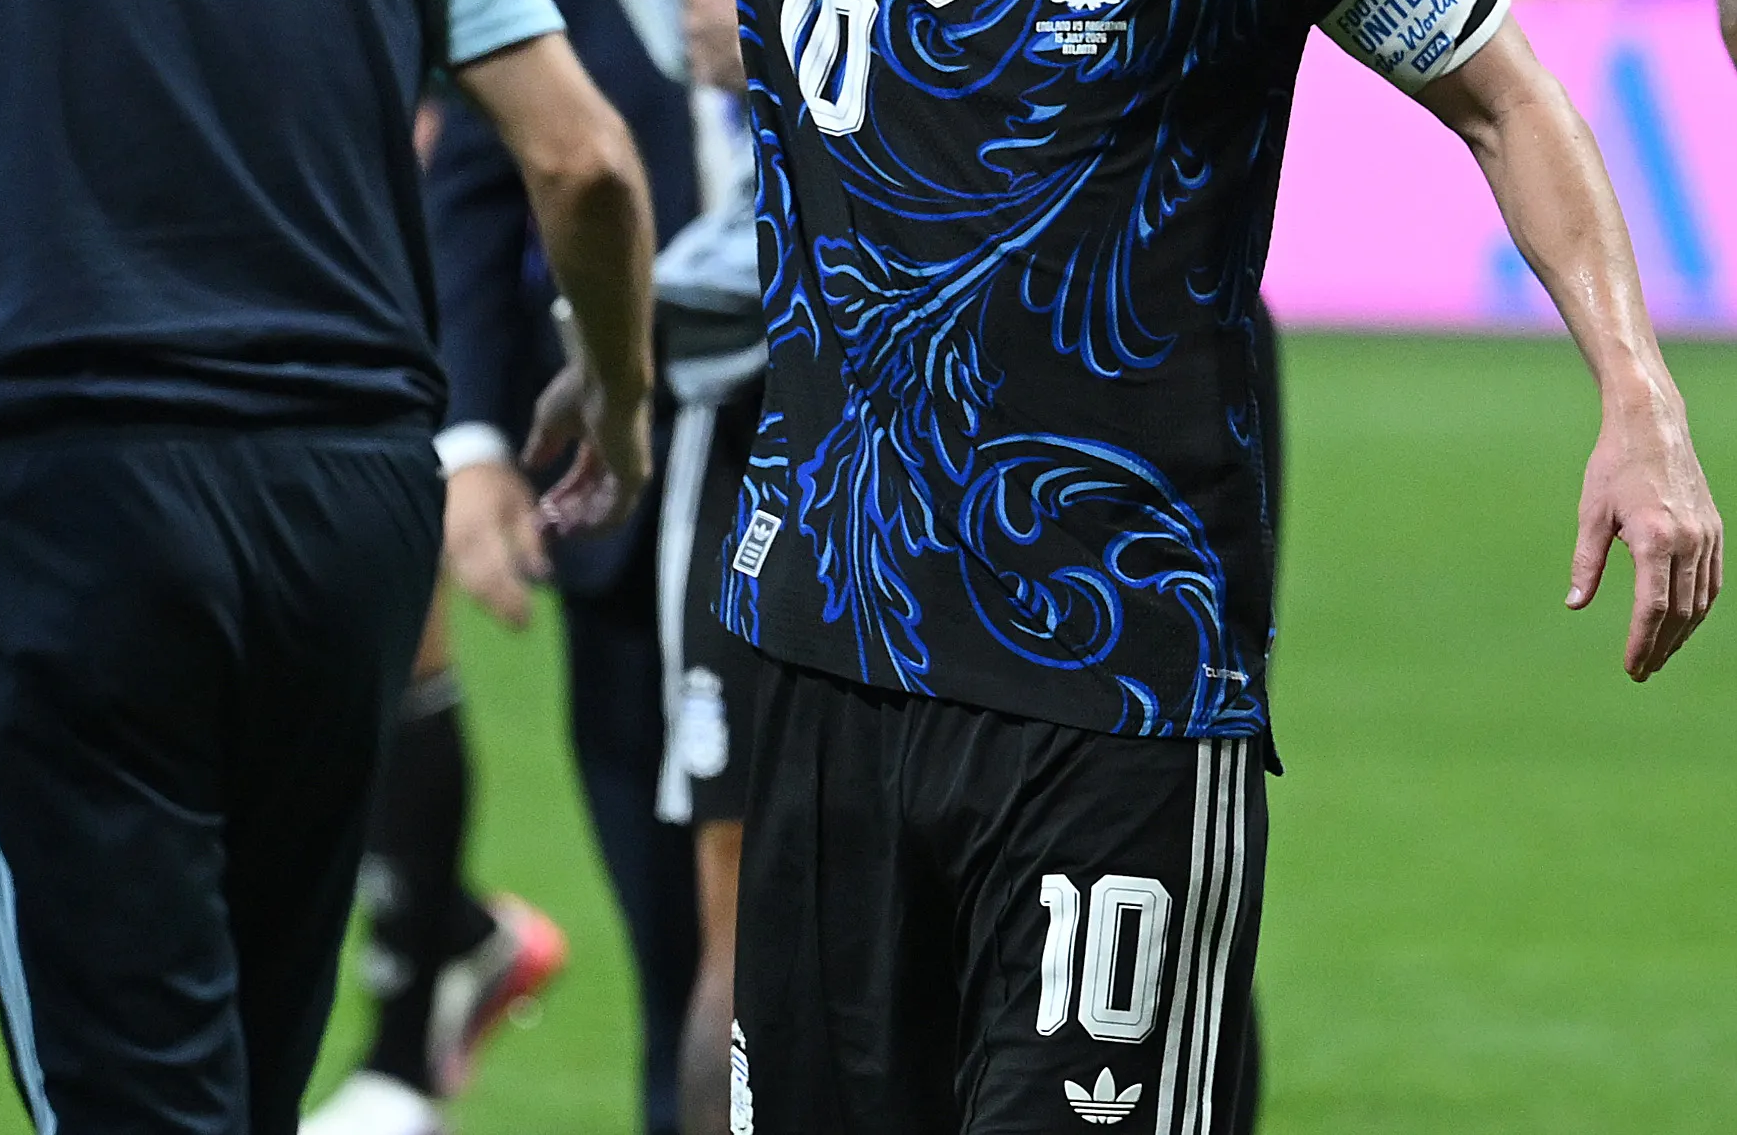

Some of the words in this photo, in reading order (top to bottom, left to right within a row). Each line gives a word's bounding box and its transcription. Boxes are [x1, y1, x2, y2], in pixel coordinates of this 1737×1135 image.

[1375, 49, 1405, 74] the
[1413, 33, 1453, 72] FIFA
[1036, 874, 1172, 1044] 10
